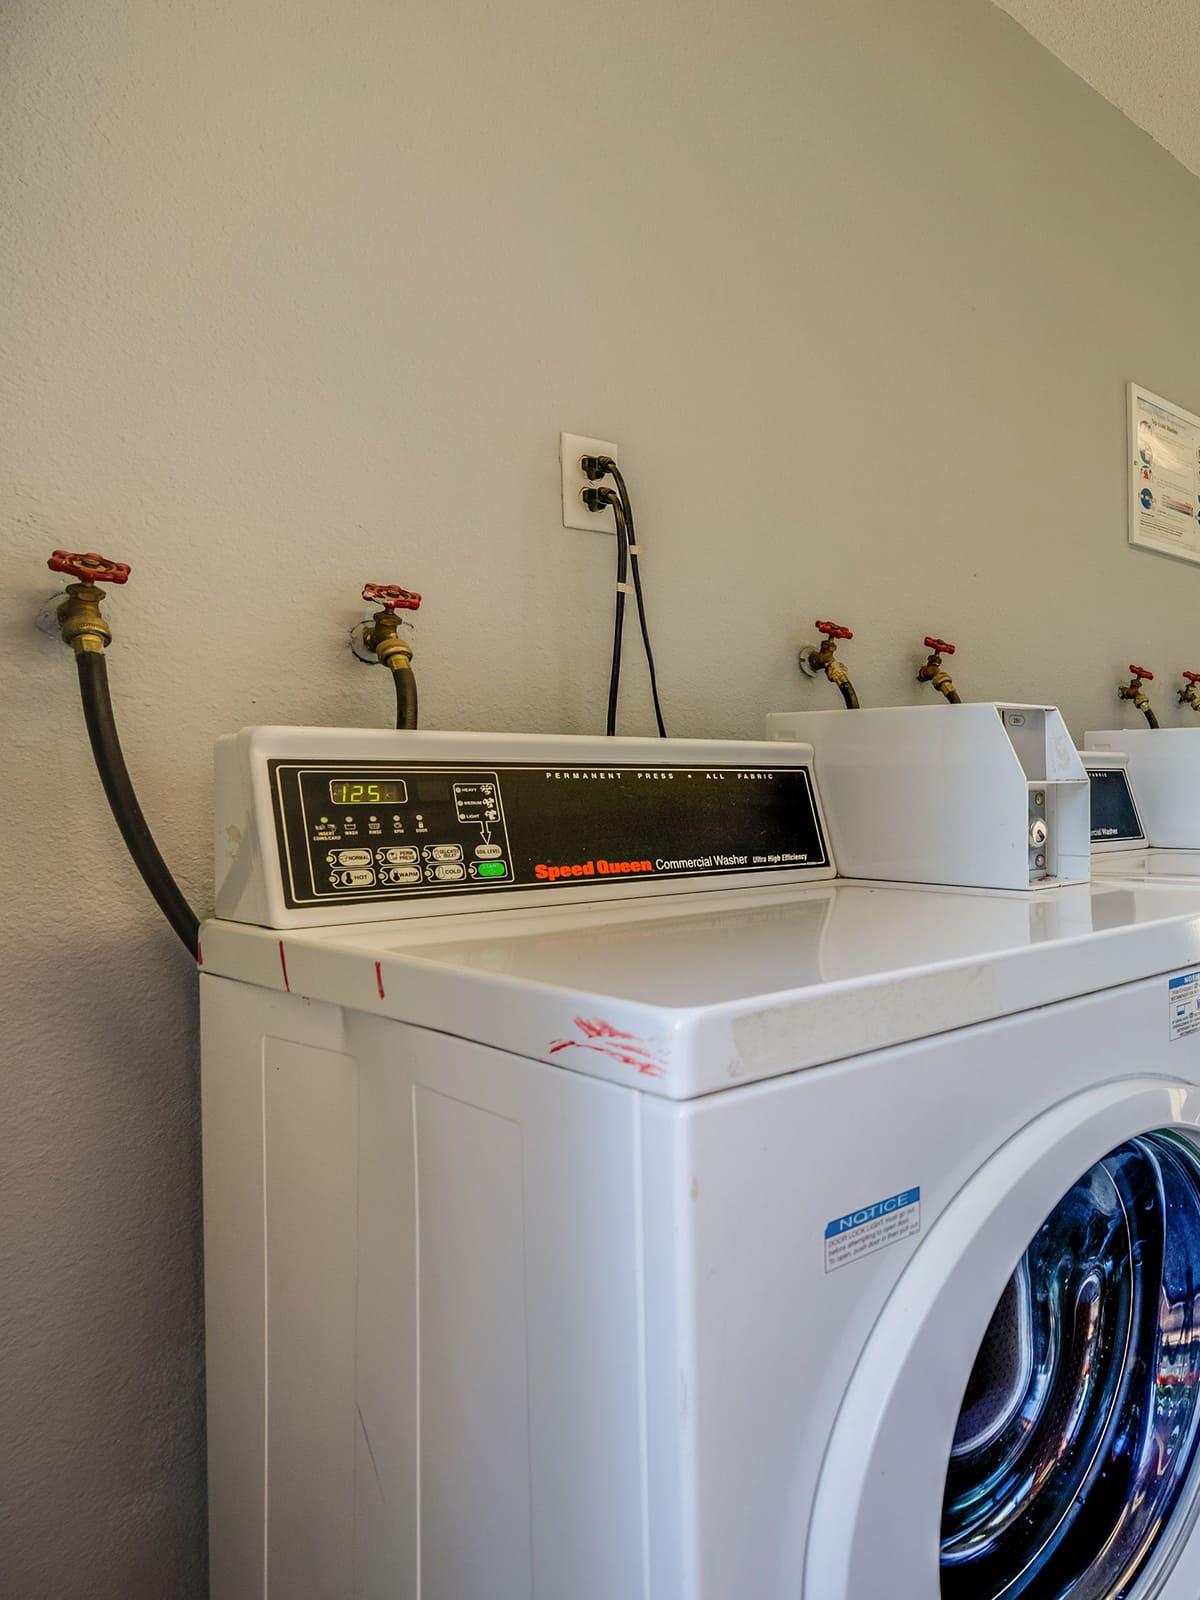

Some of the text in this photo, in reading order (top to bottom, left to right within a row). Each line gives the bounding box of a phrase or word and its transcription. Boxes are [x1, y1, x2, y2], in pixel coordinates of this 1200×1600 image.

[546, 772, 622, 780] PERMANENT
[637, 772, 675, 780] PRESS
[342, 785, 380, 802] 125
[655, 854, 748, 870] Commercial Washer
[752, 854, 808, 864] Ultra High Efficiency
[534, 860, 653, 880] Speed Queen
[840, 1193, 909, 1231] NOTICE
[848, 1228, 865, 1239] LOCK
[866, 1219, 883, 1231] LIGHT
